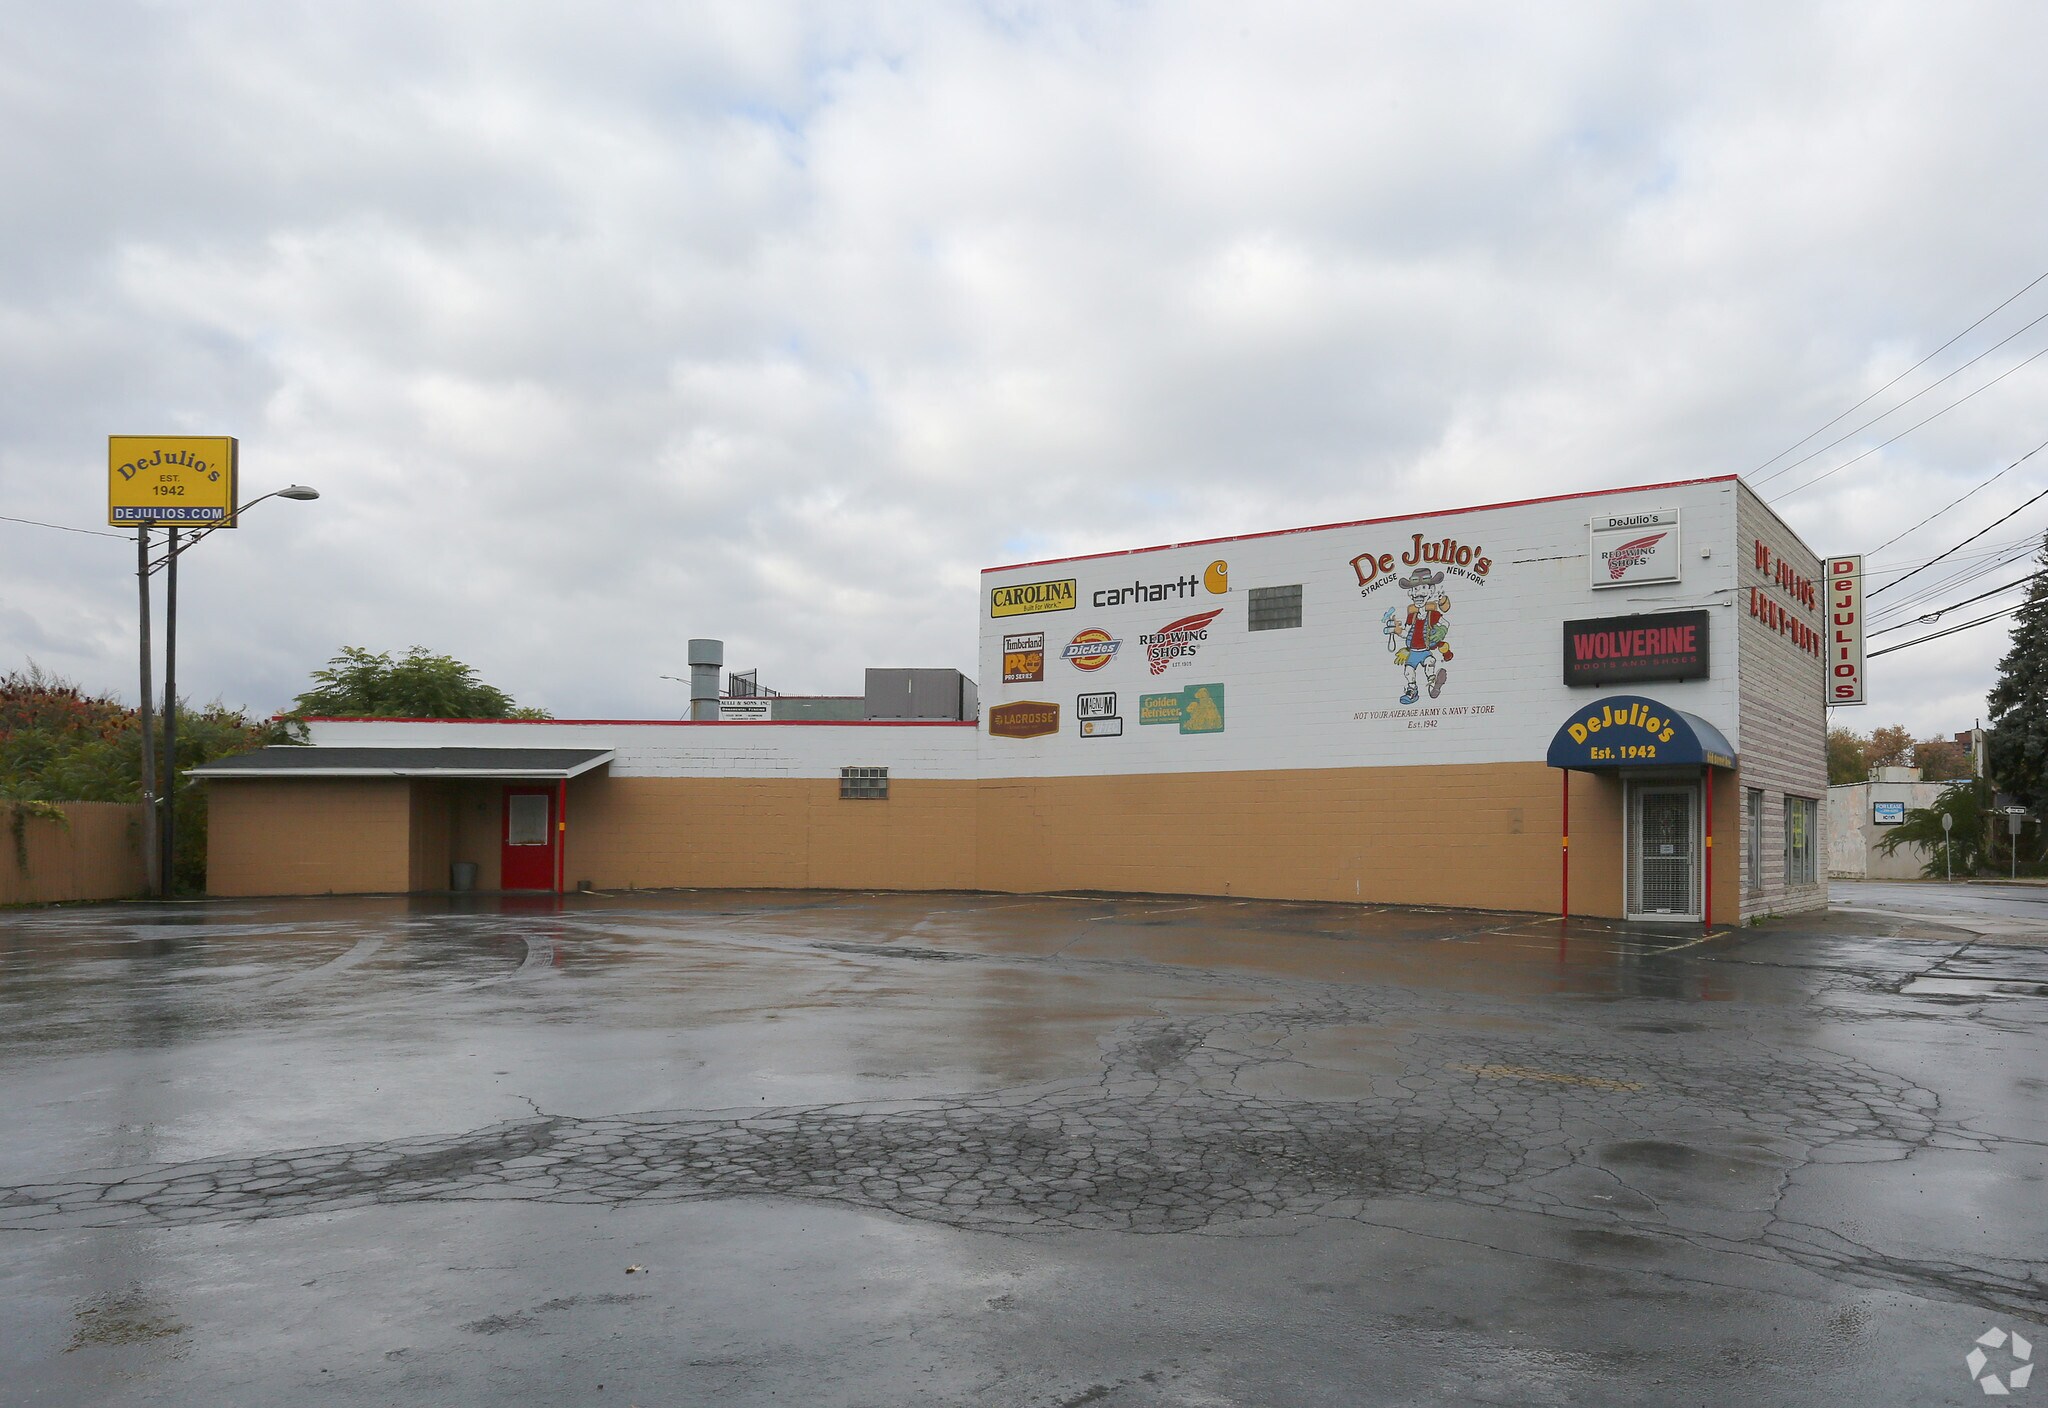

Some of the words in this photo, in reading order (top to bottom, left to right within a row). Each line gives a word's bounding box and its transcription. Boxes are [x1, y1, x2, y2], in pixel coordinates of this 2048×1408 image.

[118, 450, 220, 482] DeJulio's
[160, 474, 180, 482] EST.
[153, 486, 184, 496] 1942
[116, 508, 222, 519] DEJULIOS.COM
[1609, 514, 1659, 527] DeJulio's
[1349, 552, 1395, 587] De
[1402, 533, 1492, 576] Julio's
[1602, 550, 1623, 559] RED
[1626, 547, 1655, 556] WING
[1755, 540, 1771, 576] DE
[1612, 557, 1646, 568] SHOES
[1361, 573, 1398, 598] SYRACUSE
[1447, 566, 1465, 577] NEW
[1465, 571, 1485, 587] YORK
[994, 583, 1072, 607] CAROLINA
[1093, 574, 1199, 607] carhartt
[1006, 636, 1042, 650] Timberland
[1140, 634, 1165, 645] RED
[1170, 630, 1208, 643] WING
[1573, 626, 1696, 660] WOLVERINE
[1067, 643, 1116, 656] Dickies
[1152, 645, 1196, 658] SHOES
[1574, 661, 1616, 670] BOOTS
[1654, 656, 1697, 665] SHOES
[1081, 697, 1112, 715] MAGNUM
[1145, 696, 1177, 708] Golden
[1004, 712, 1053, 724] LACROSSE
[1142, 707, 1180, 718] Retriever
[1354, 712, 1368, 720] NOT
[1370, 711, 1390, 719] YOUR
[1390, 709, 1418, 718] AVERAGE
[1419, 708, 1440, 716] ARMY
[1449, 706, 1469, 715] NAVY
[1471, 705, 1495, 714] STORE
[1424, 720, 1438, 728] 1942
[1568, 703, 1675, 745] DeJulio's
[1590, 746, 1616, 759] Est.
[1620, 745, 1656, 758] 1942
